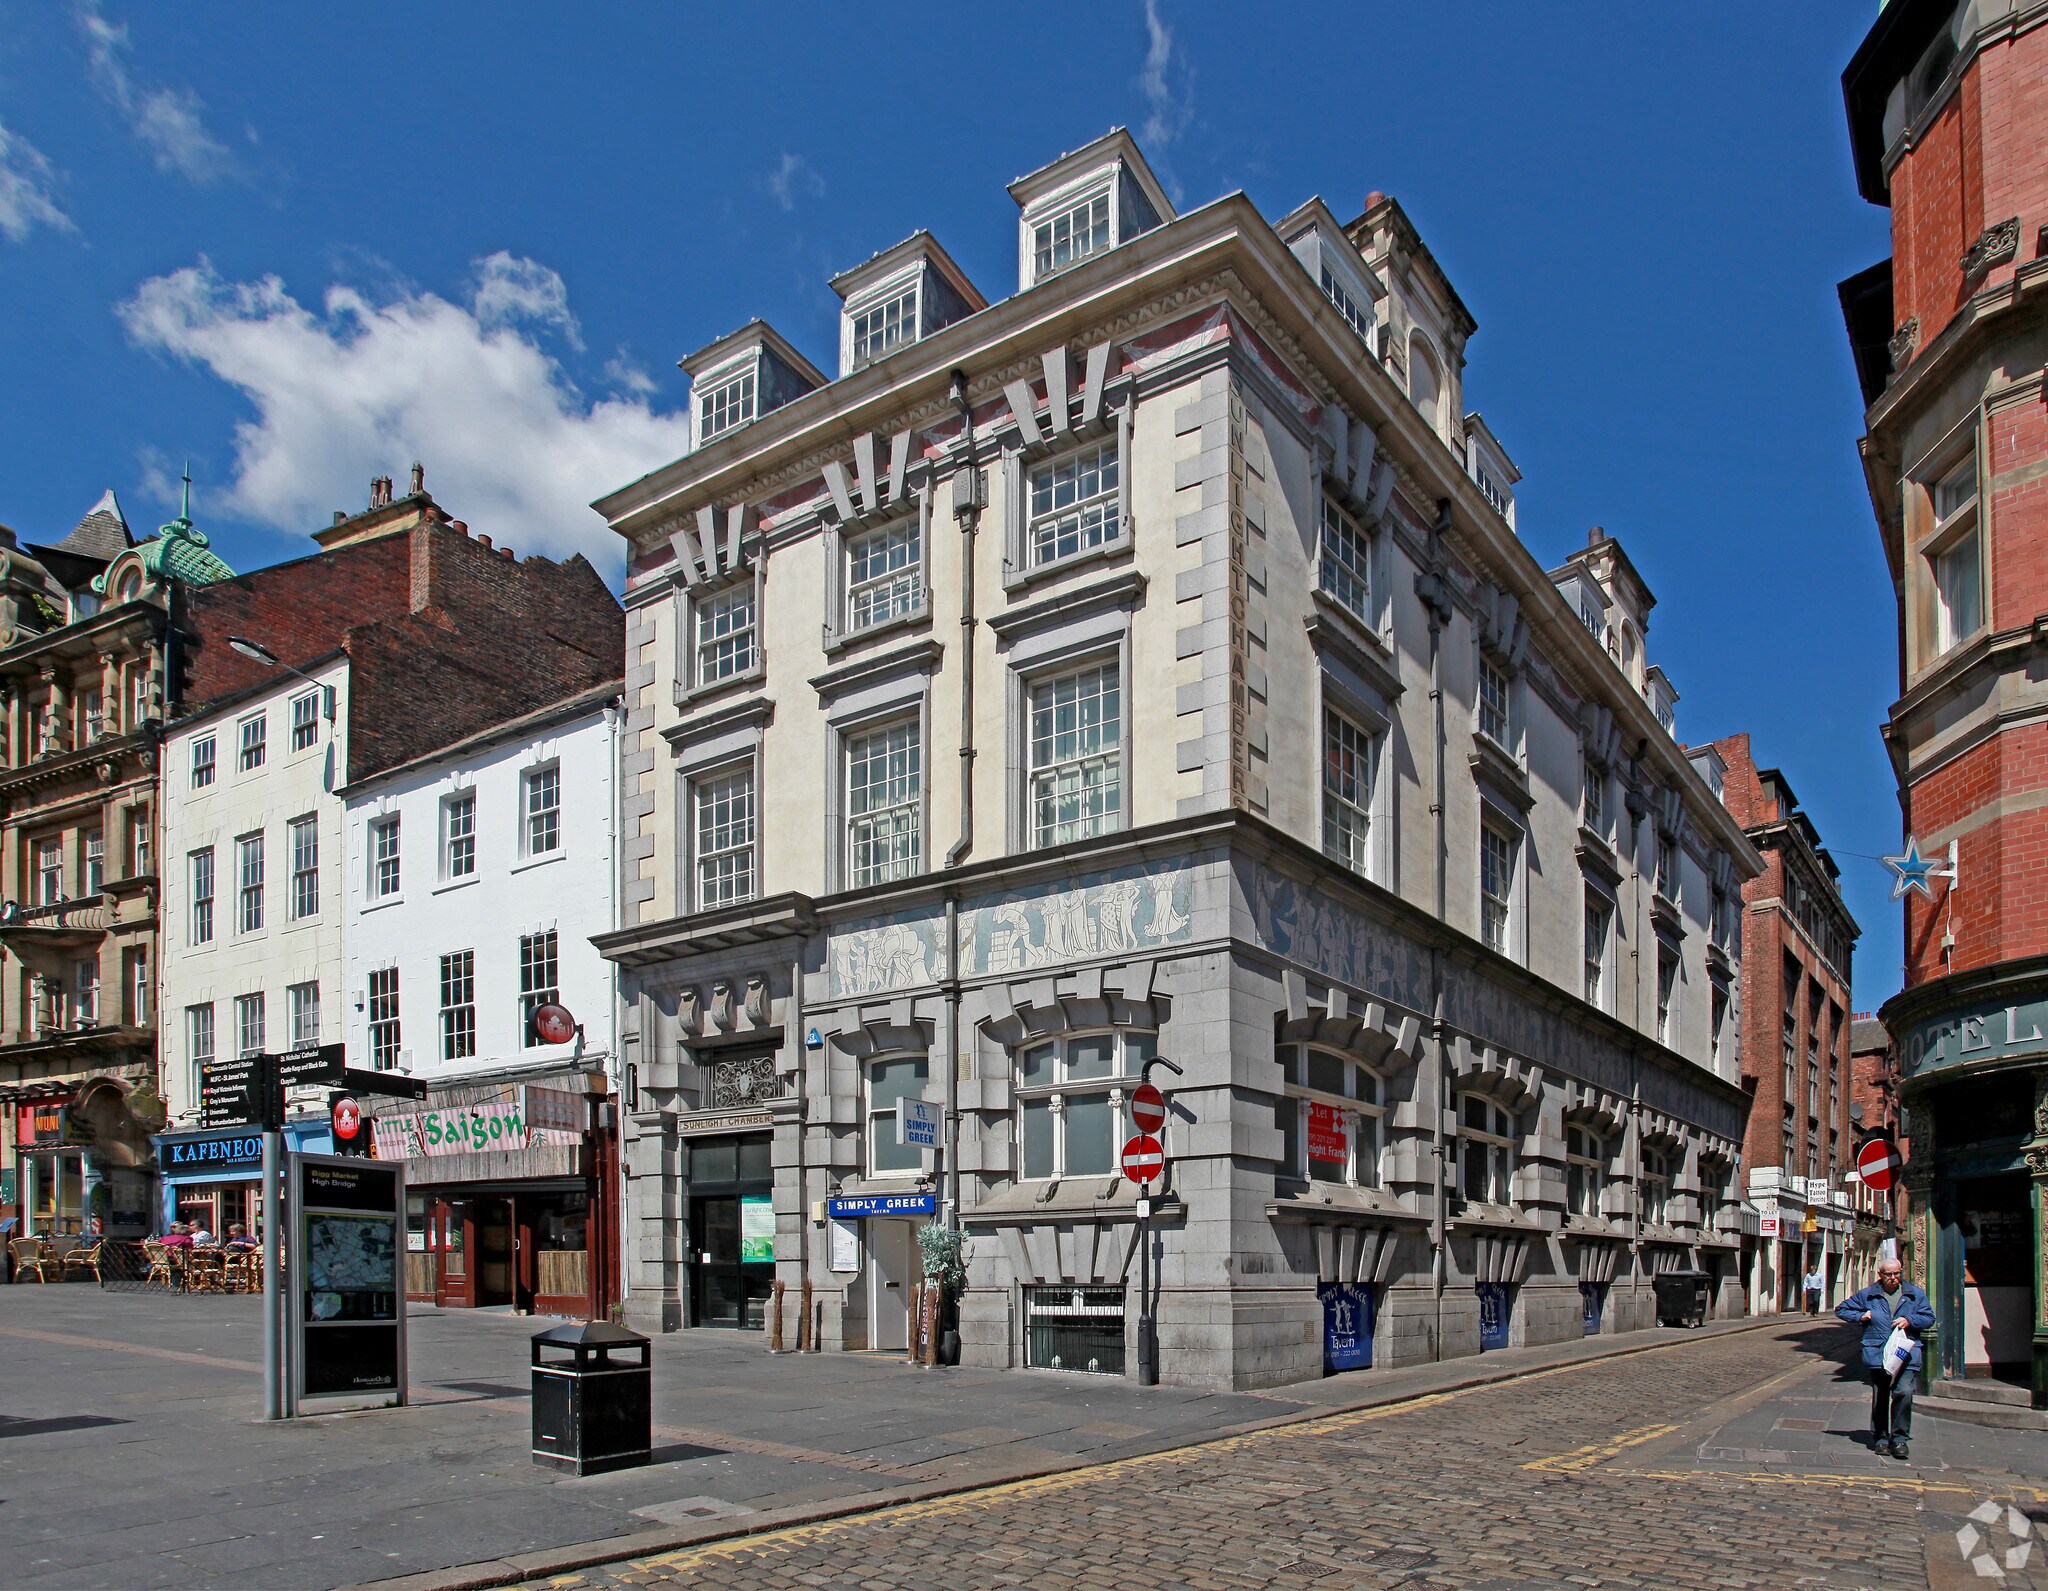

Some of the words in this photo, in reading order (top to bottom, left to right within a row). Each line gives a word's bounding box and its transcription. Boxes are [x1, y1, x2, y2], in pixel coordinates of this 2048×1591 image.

[1229, 374, 1244, 592] SUNLIGHT
[1900, 1006, 2043, 1072] HOTEL
[302, 1050, 319, 1059] Cathedral
[318, 1060, 328, 1068] Gate
[280, 1077, 297, 1086] Quayside
[1316, 1105, 1328, 1119] Let
[210, 1117, 236, 1126] Northumberland
[683, 1119, 723, 1130] SUNLIGHT
[728, 1114, 774, 1126] CHAMBERS
[906, 1119, 936, 1133] SIMPLY
[375, 1119, 414, 1135] LITTLE
[425, 1111, 524, 1149] Saigon
[909, 1131, 934, 1145] GREEK
[1308, 1142, 1327, 1157] night
[1328, 1145, 1347, 1158] Frank
[311, 1169, 331, 1179] Bigg
[332, 1171, 359, 1180] Market
[312, 1178, 330, 1187] High
[331, 1179, 356, 1188] Bridge
[1810, 1181, 1826, 1189] Hype
[836, 1199, 877, 1210] SIMPLY
[886, 1197, 925, 1208] GREEK
[1331, 1335, 1355, 1350] Tavern
